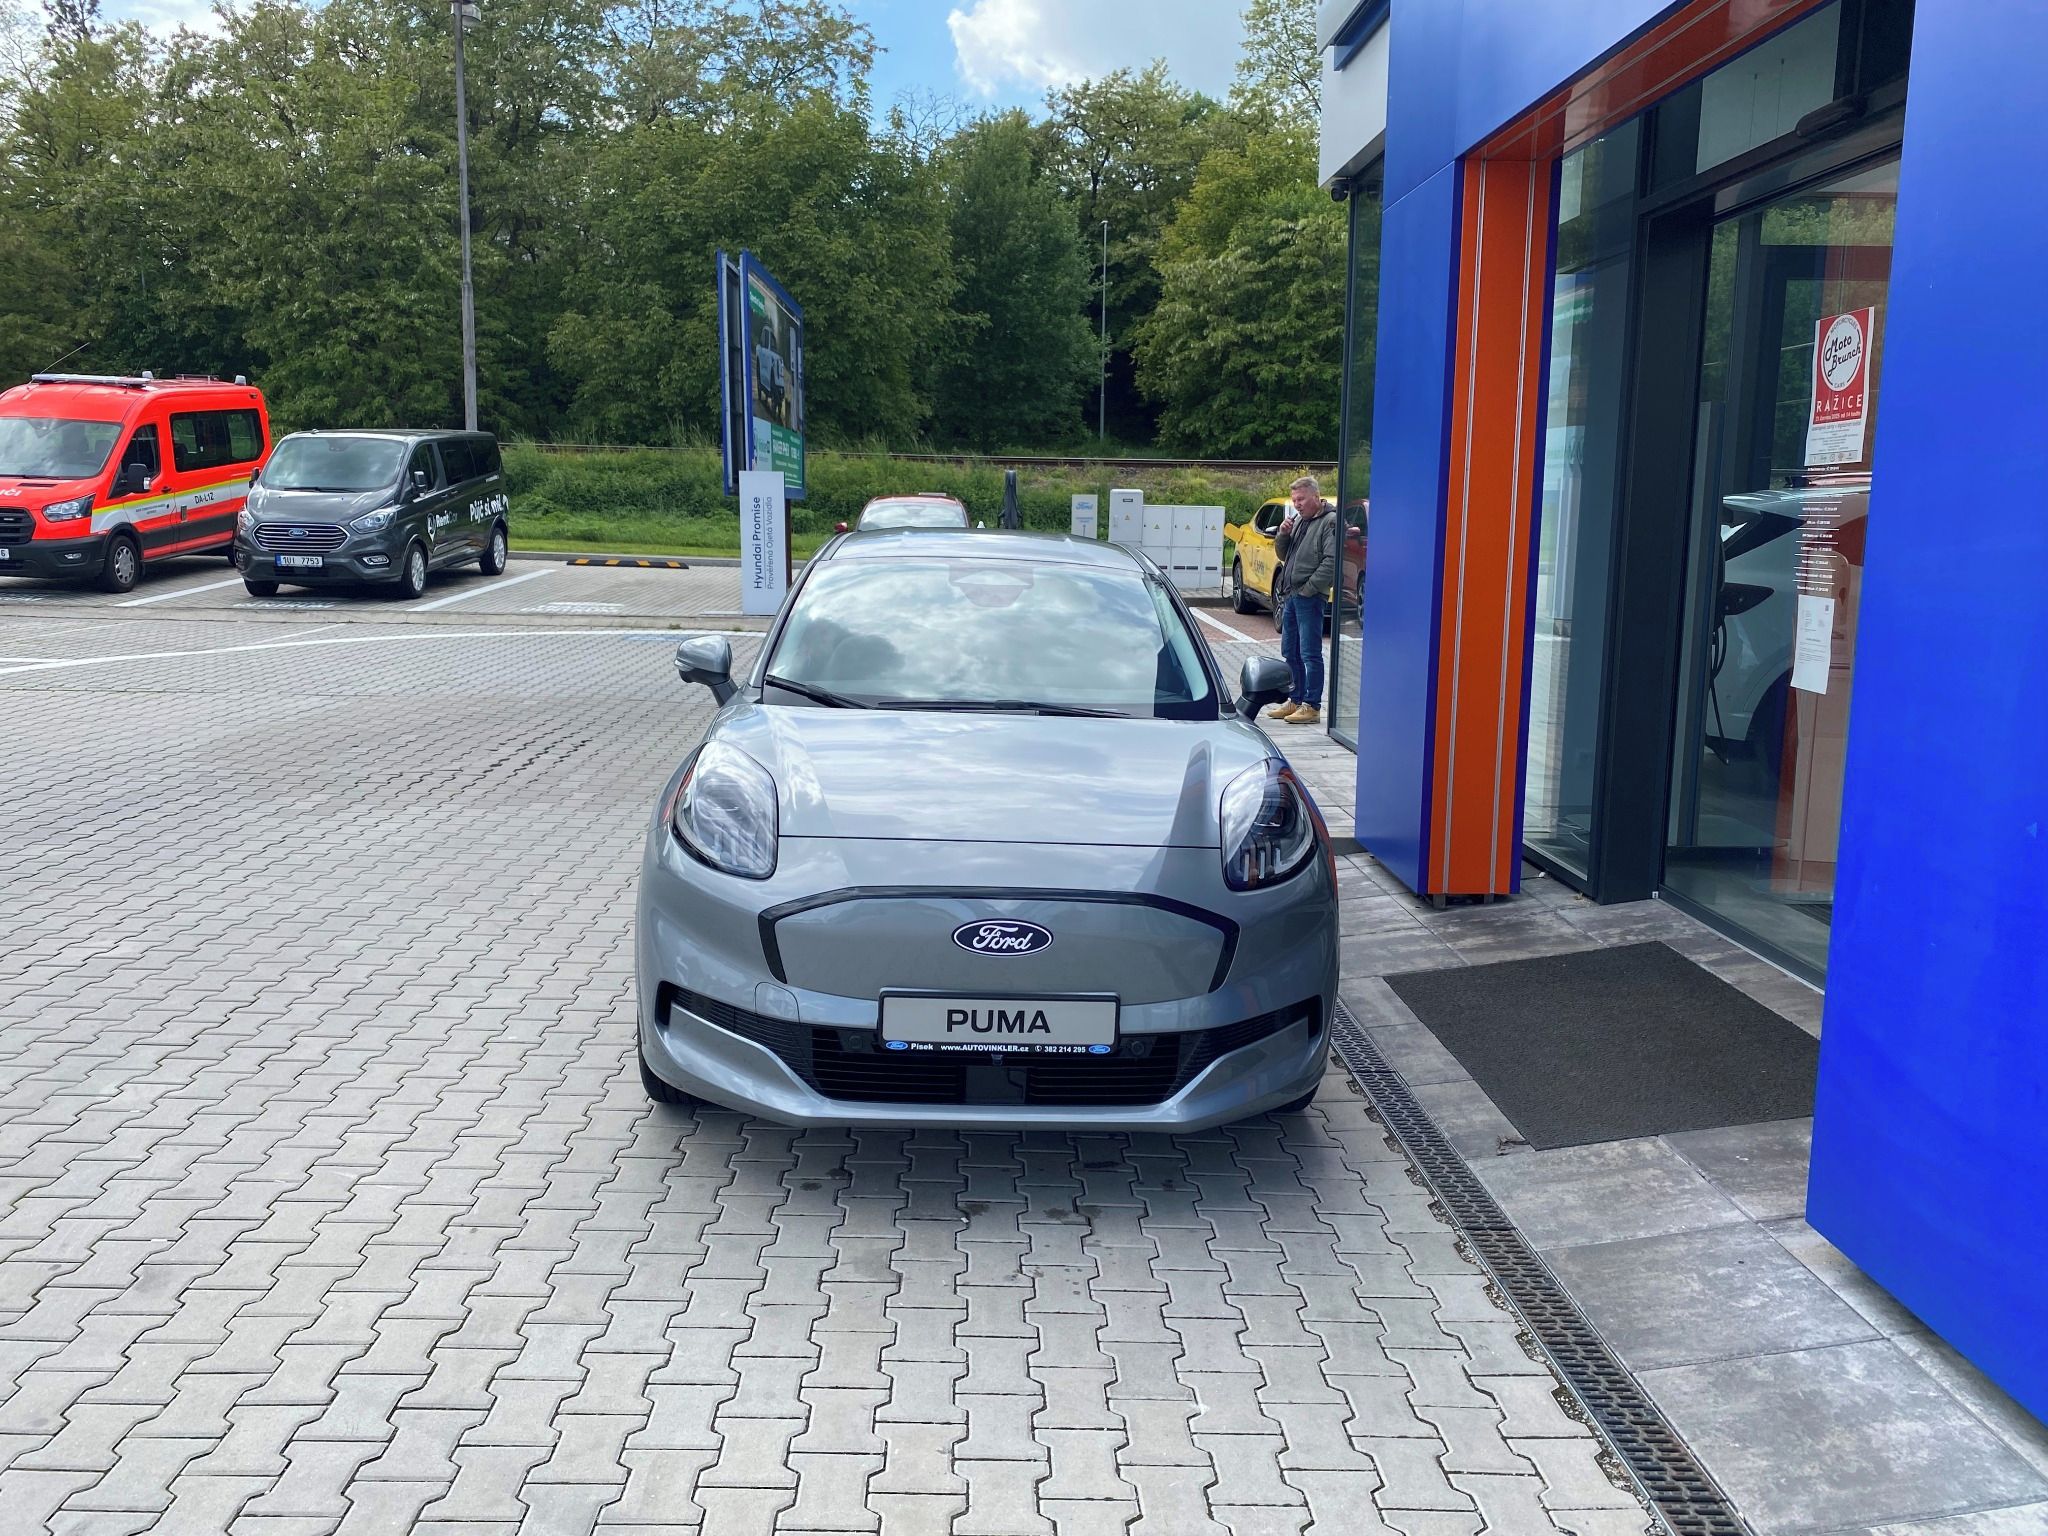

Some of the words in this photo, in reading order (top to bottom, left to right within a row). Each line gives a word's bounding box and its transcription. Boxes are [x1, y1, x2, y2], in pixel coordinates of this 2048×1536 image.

[1825, 336, 1852, 361] Moto
[1827, 342, 1861, 377] Brunch
[1816, 394, 1863, 413] RAŽICE
[751, 497, 761, 541] Promise
[301, 557, 320, 565] 7753
[753, 543, 764, 589] Hyundai
[972, 925, 1034, 950] Ford
[946, 1009, 1051, 1034] PUMA
[911, 1043, 934, 1051] Písek
[940, 1044, 1029, 1052] www.AUTOVINKLER.cz
